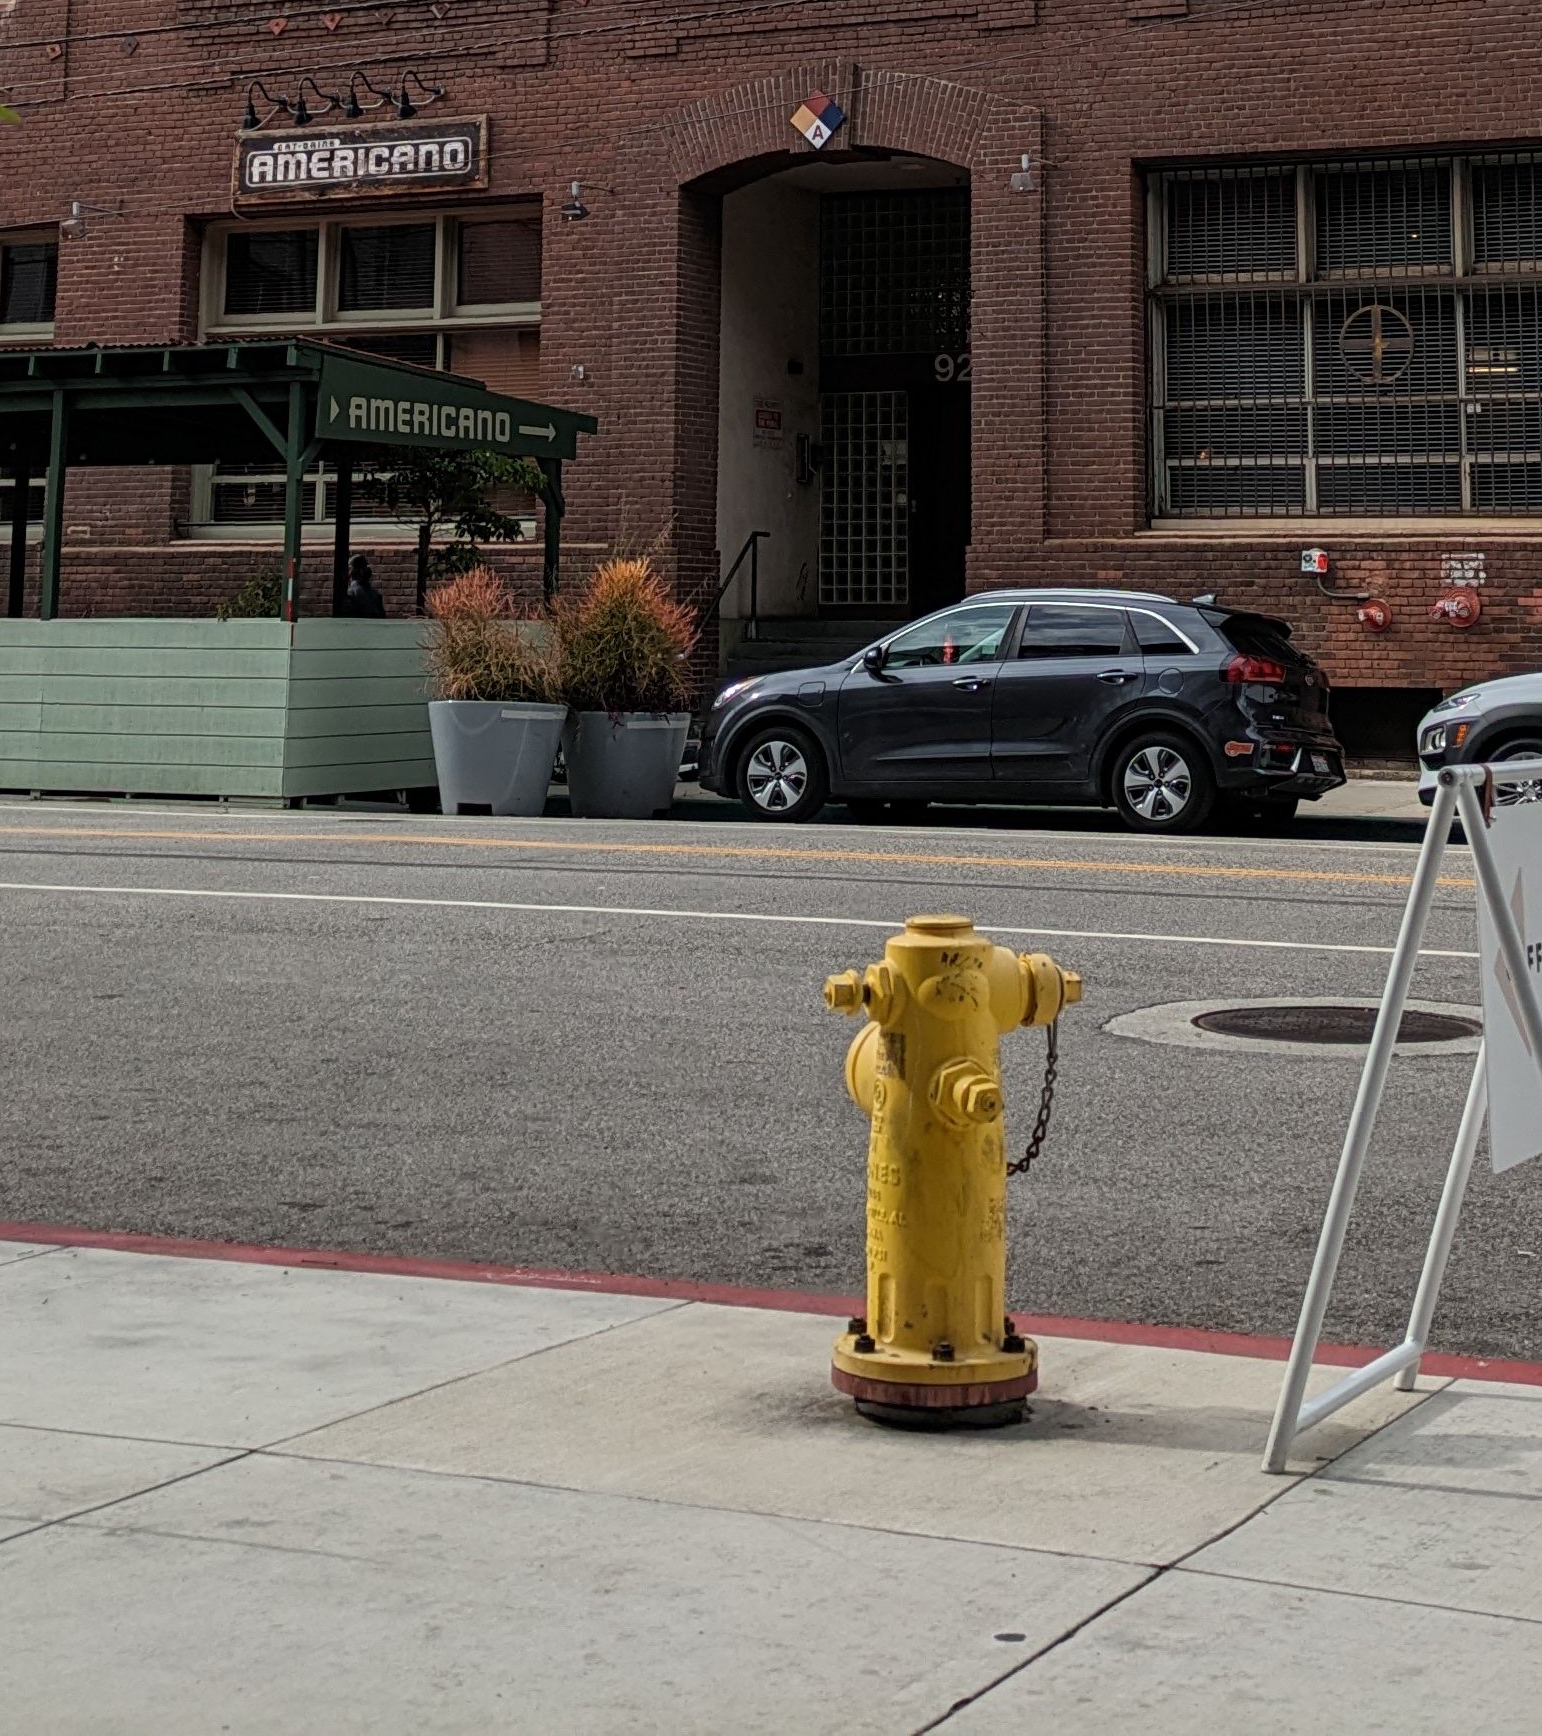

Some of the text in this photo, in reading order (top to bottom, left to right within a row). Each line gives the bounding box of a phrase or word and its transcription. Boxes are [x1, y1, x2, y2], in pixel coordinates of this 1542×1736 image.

[811, 124, 824, 140] A
[251, 141, 465, 183] AMERICANO
[348, 396, 510, 443] AMERICANO
